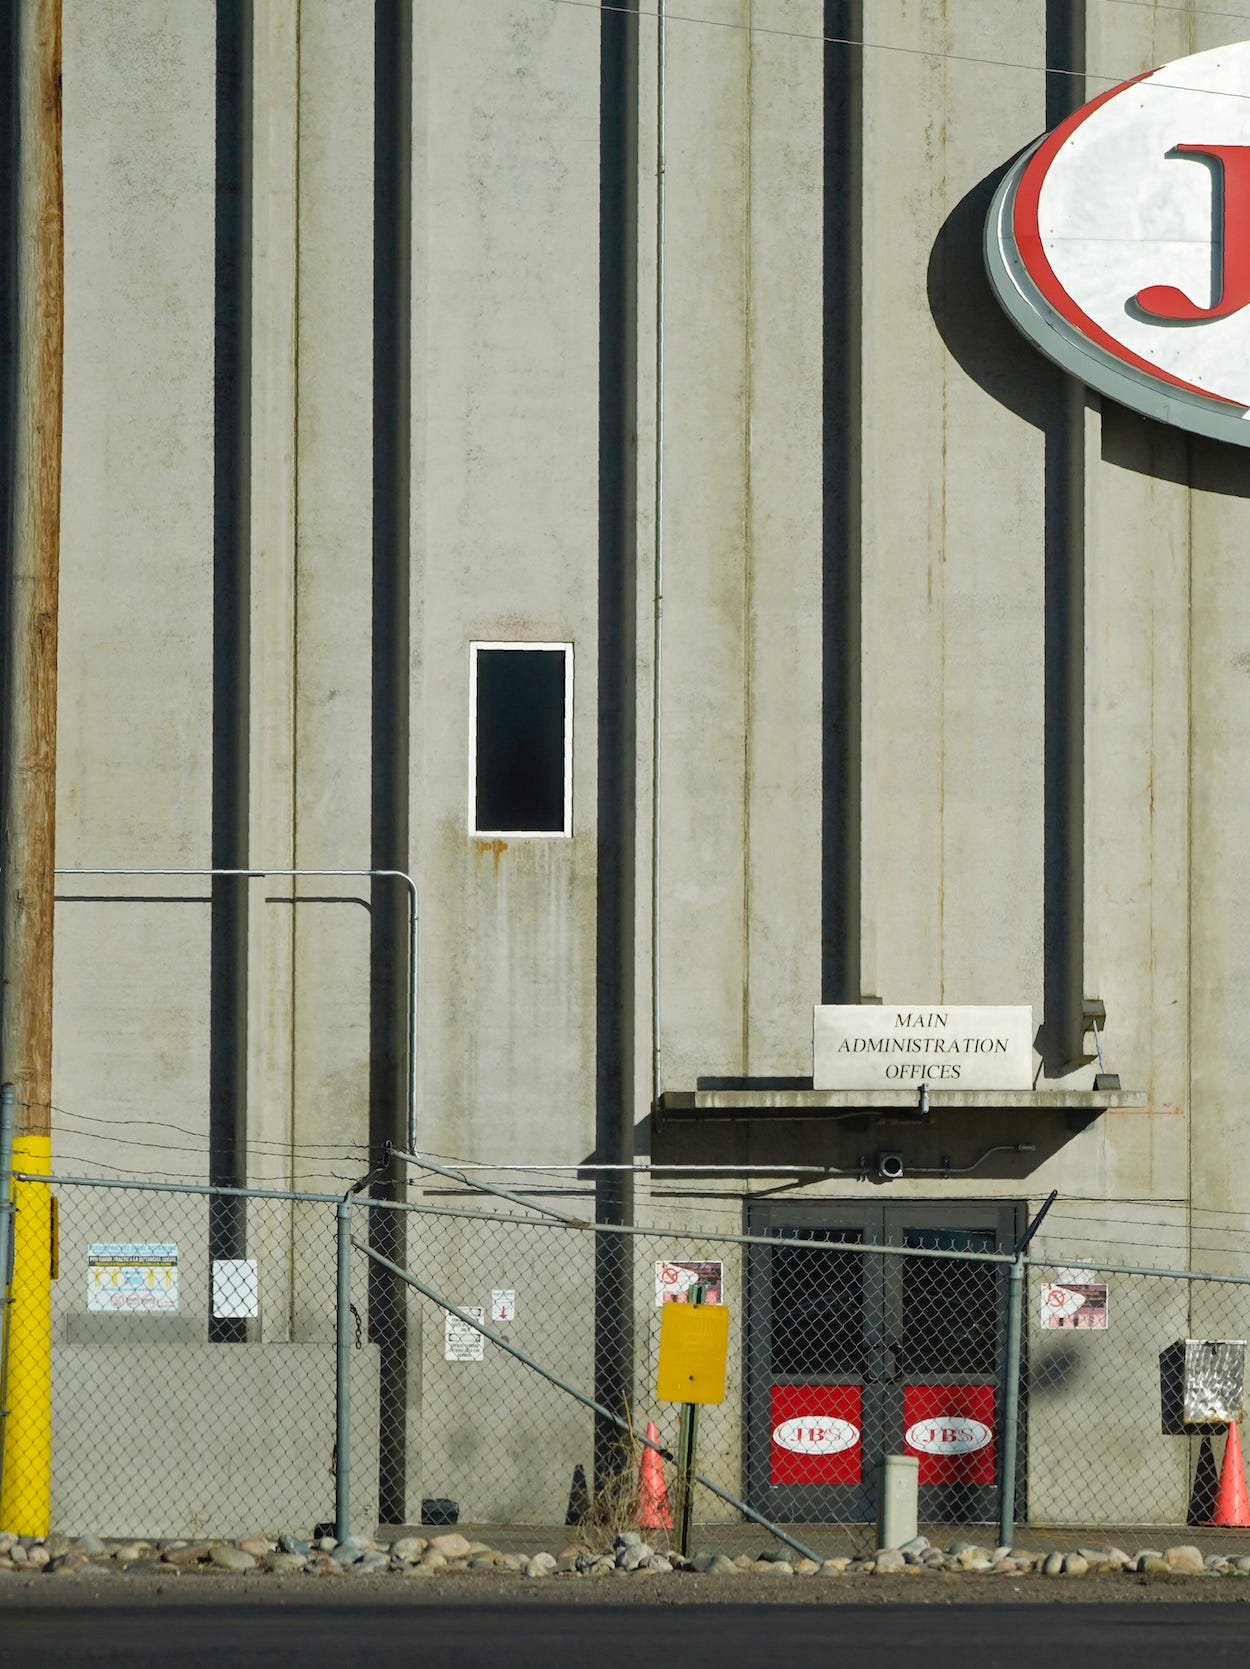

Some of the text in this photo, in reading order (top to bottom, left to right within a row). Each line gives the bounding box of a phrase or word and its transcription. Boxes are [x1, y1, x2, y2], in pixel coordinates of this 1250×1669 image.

[894, 1013, 948, 1028] MAIN
[837, 1038, 1009, 1053] ADMINISTRATION
[885, 1064, 961, 1079] OFFICES
[789, 1427, 841, 1442] JBS
[922, 1428, 974, 1443] JBS
